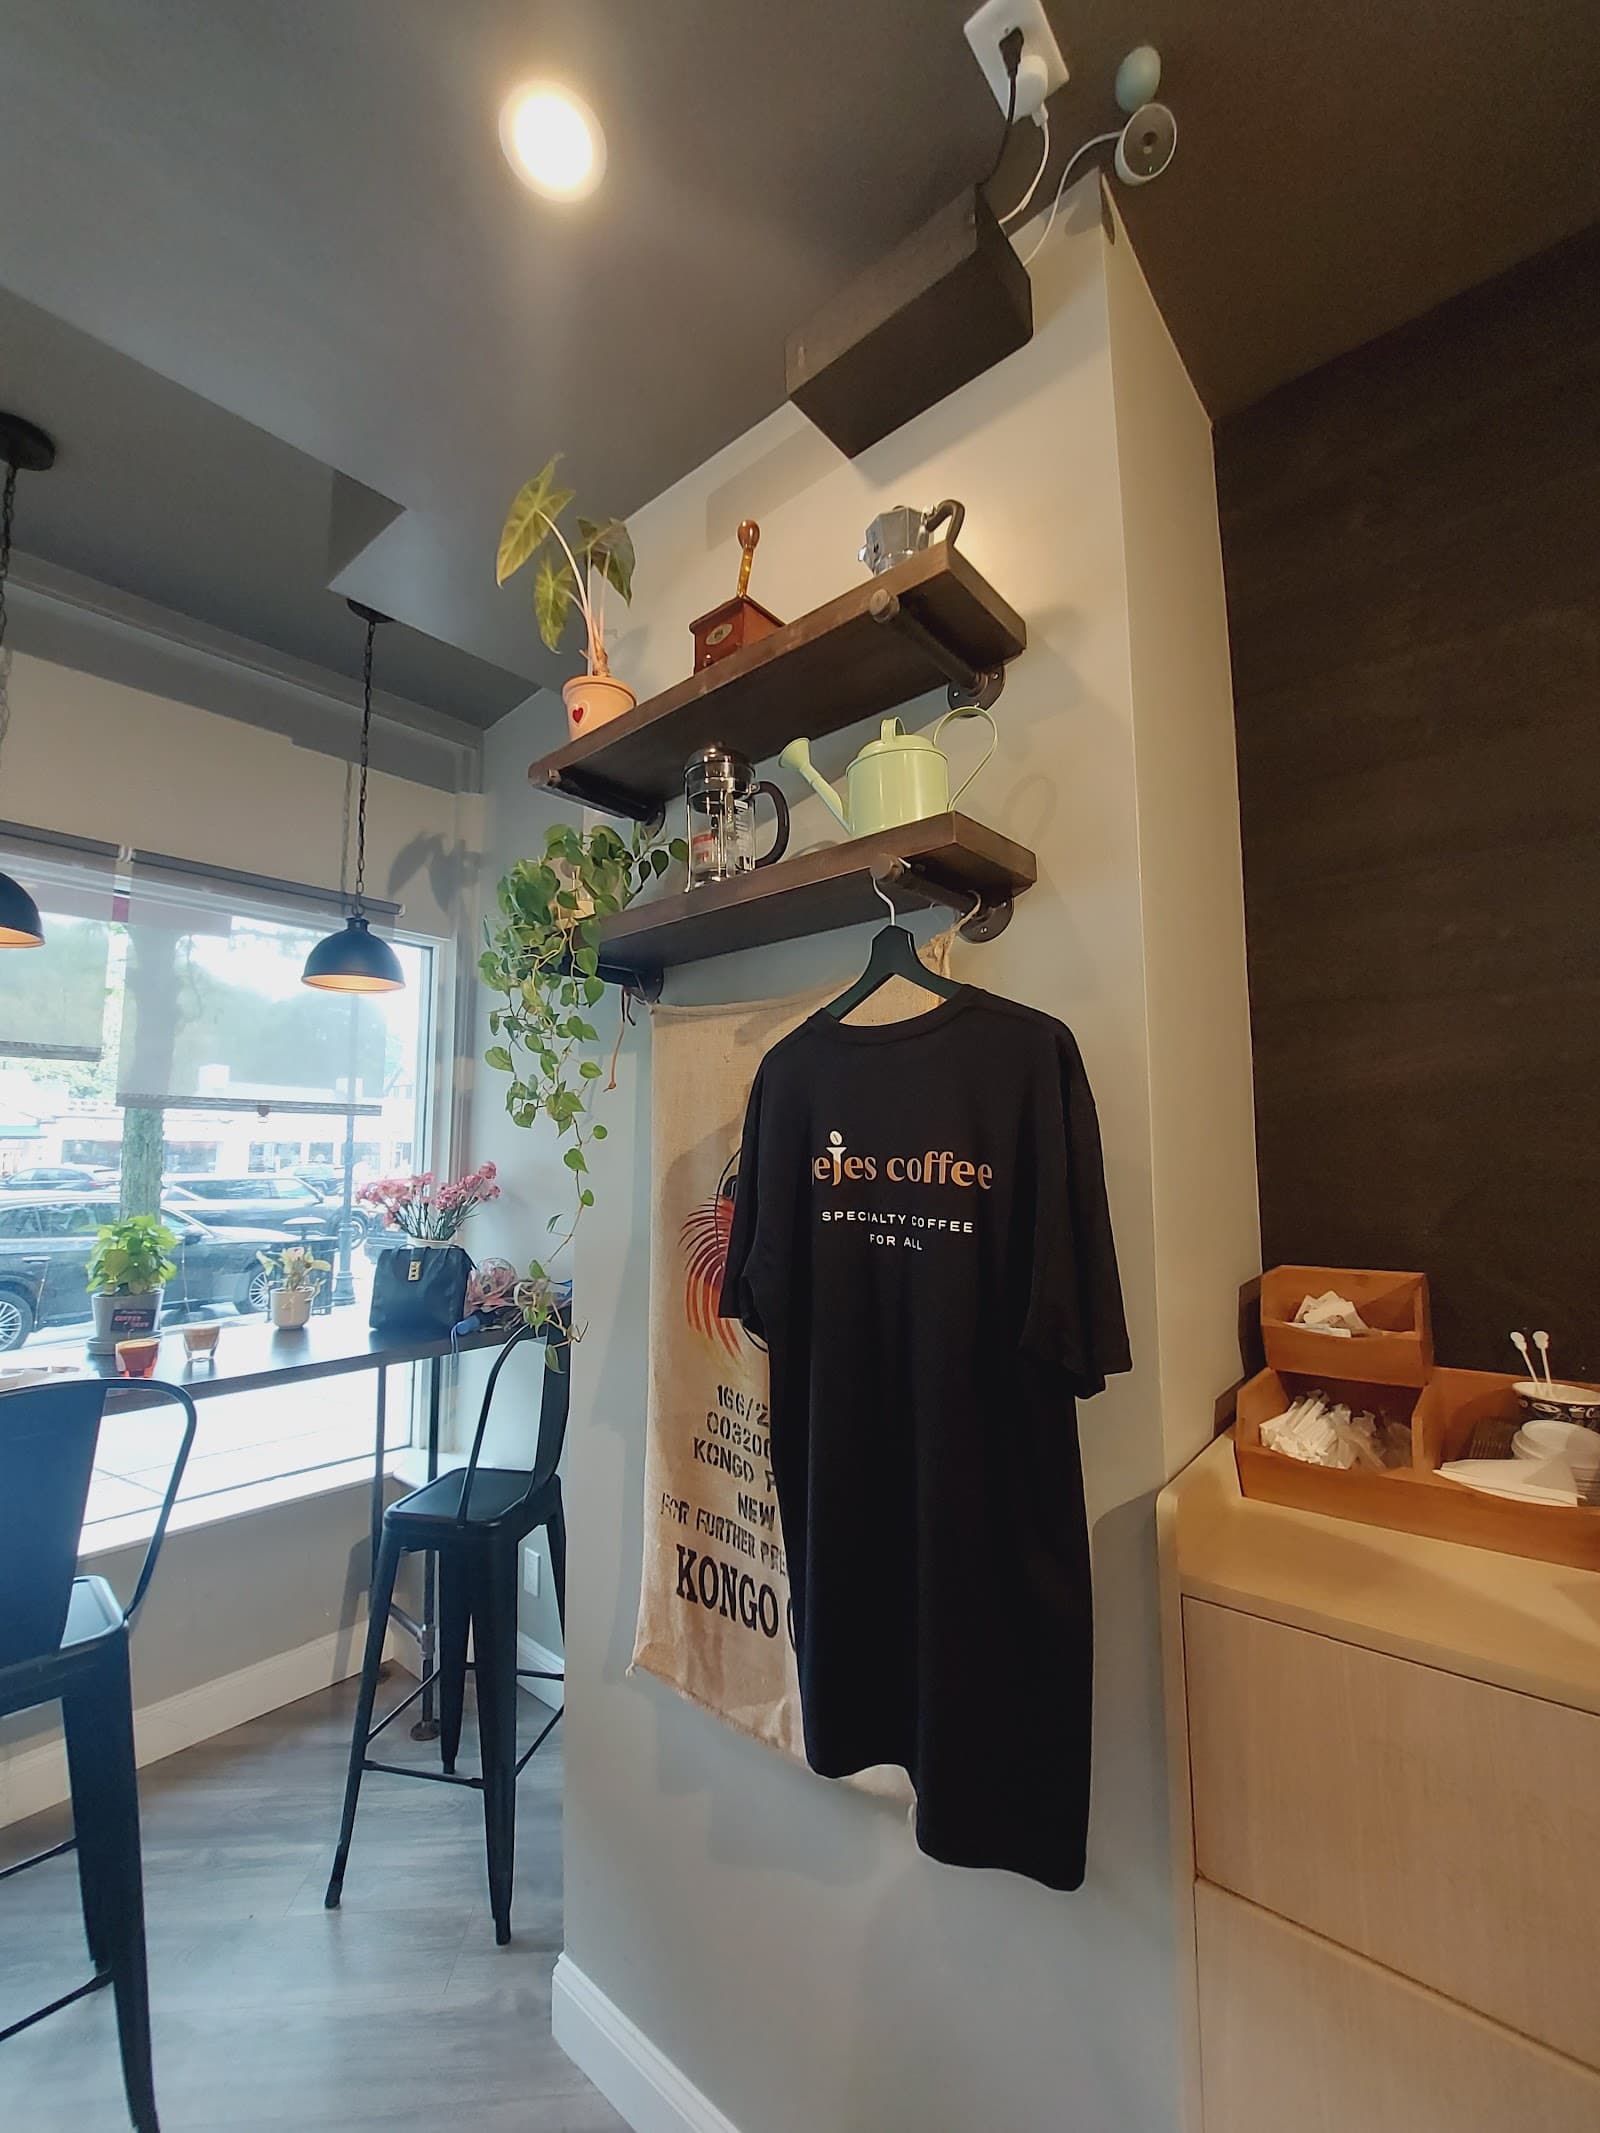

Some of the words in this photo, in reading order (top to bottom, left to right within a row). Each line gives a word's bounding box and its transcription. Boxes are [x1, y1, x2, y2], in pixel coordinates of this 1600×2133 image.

[886, 1151, 992, 1189] coffee
[821, 1211, 906, 1225] SPECIALTY
[911, 1216, 974, 1233] COFFEE
[869, 1233, 896, 1246] FOR
[903, 1236, 923, 1251] ALL
[694, 1436, 754, 1484] KONGO
[660, 1492, 690, 1525] FOR
[696, 1507, 756, 1559] FURTHER
[737, 1492, 775, 1532] NEW
[676, 1543, 780, 1639] KONGO
